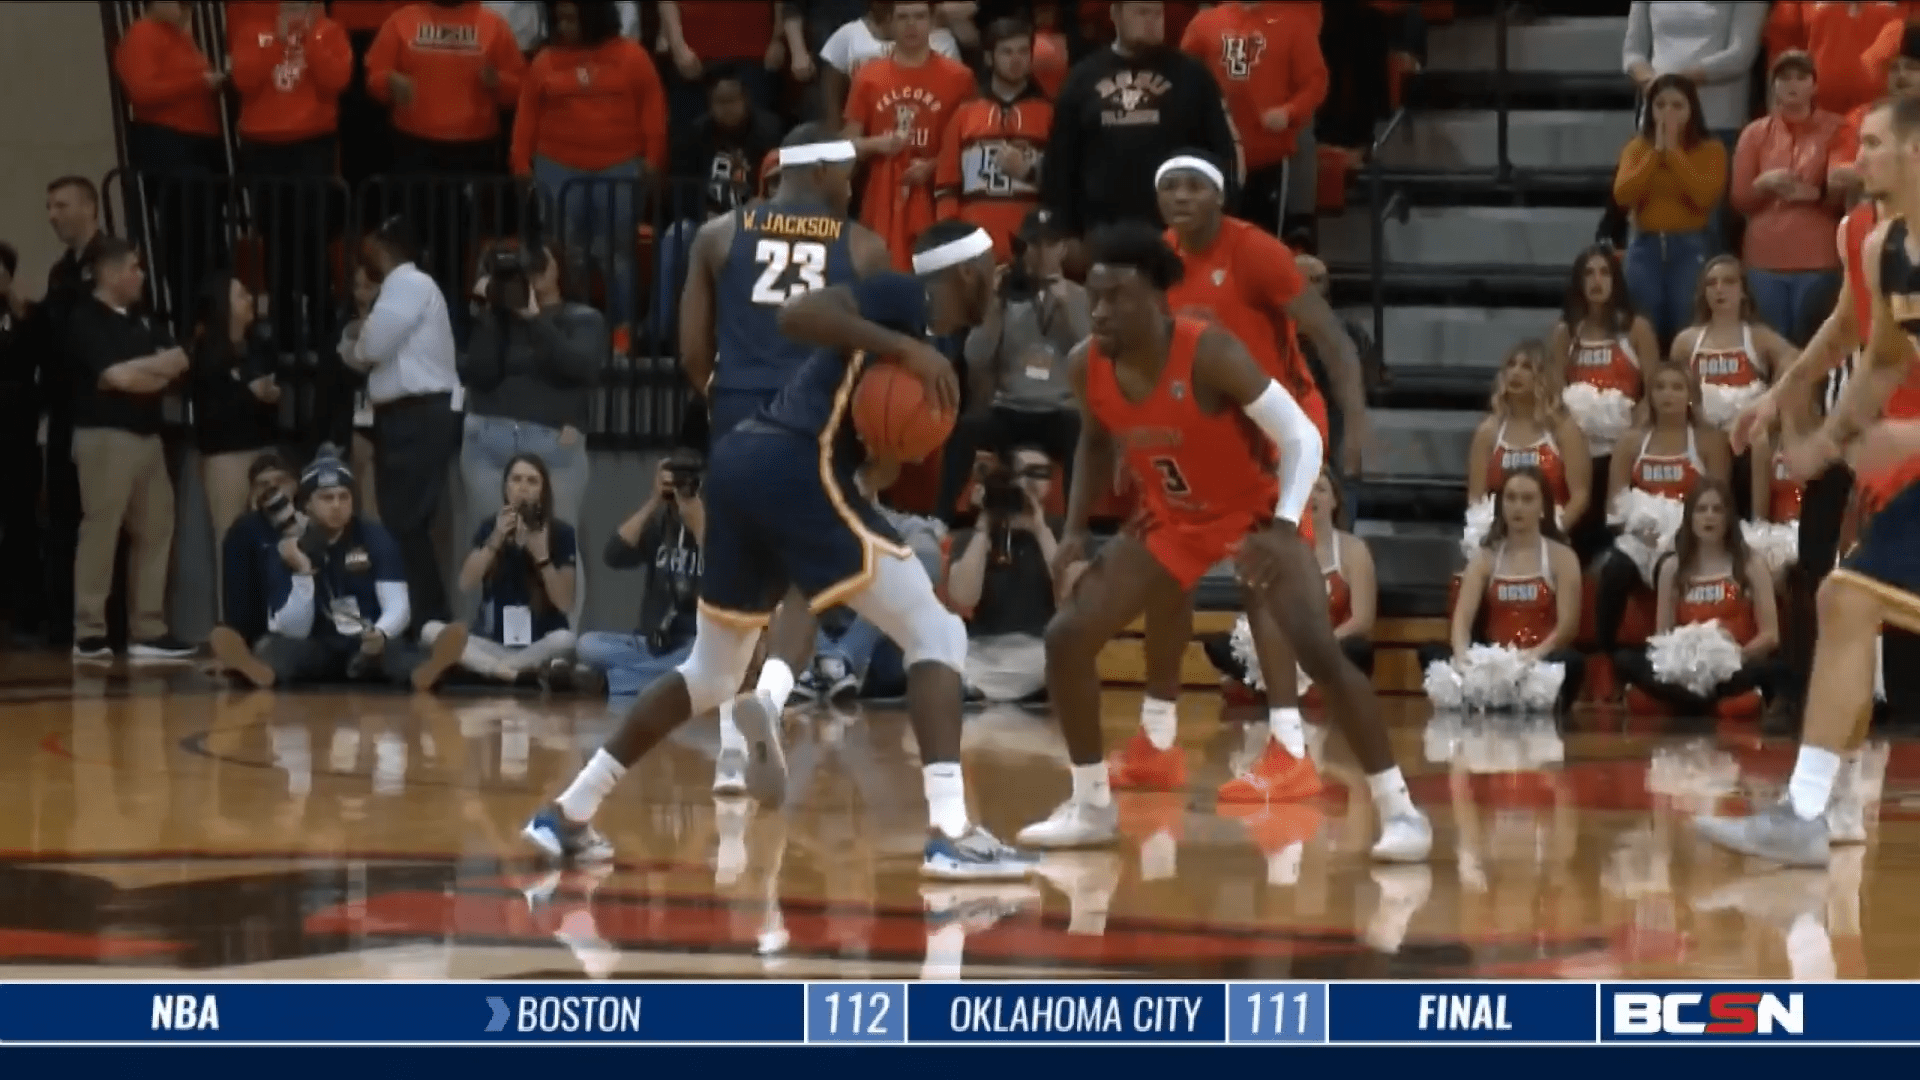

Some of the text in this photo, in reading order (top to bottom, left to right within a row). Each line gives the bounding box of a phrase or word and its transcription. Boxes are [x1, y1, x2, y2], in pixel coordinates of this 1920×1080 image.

[743, 210, 842, 239] W. JACKSON
[751, 239, 826, 303] 23
[1150, 456, 1192, 496] 3
